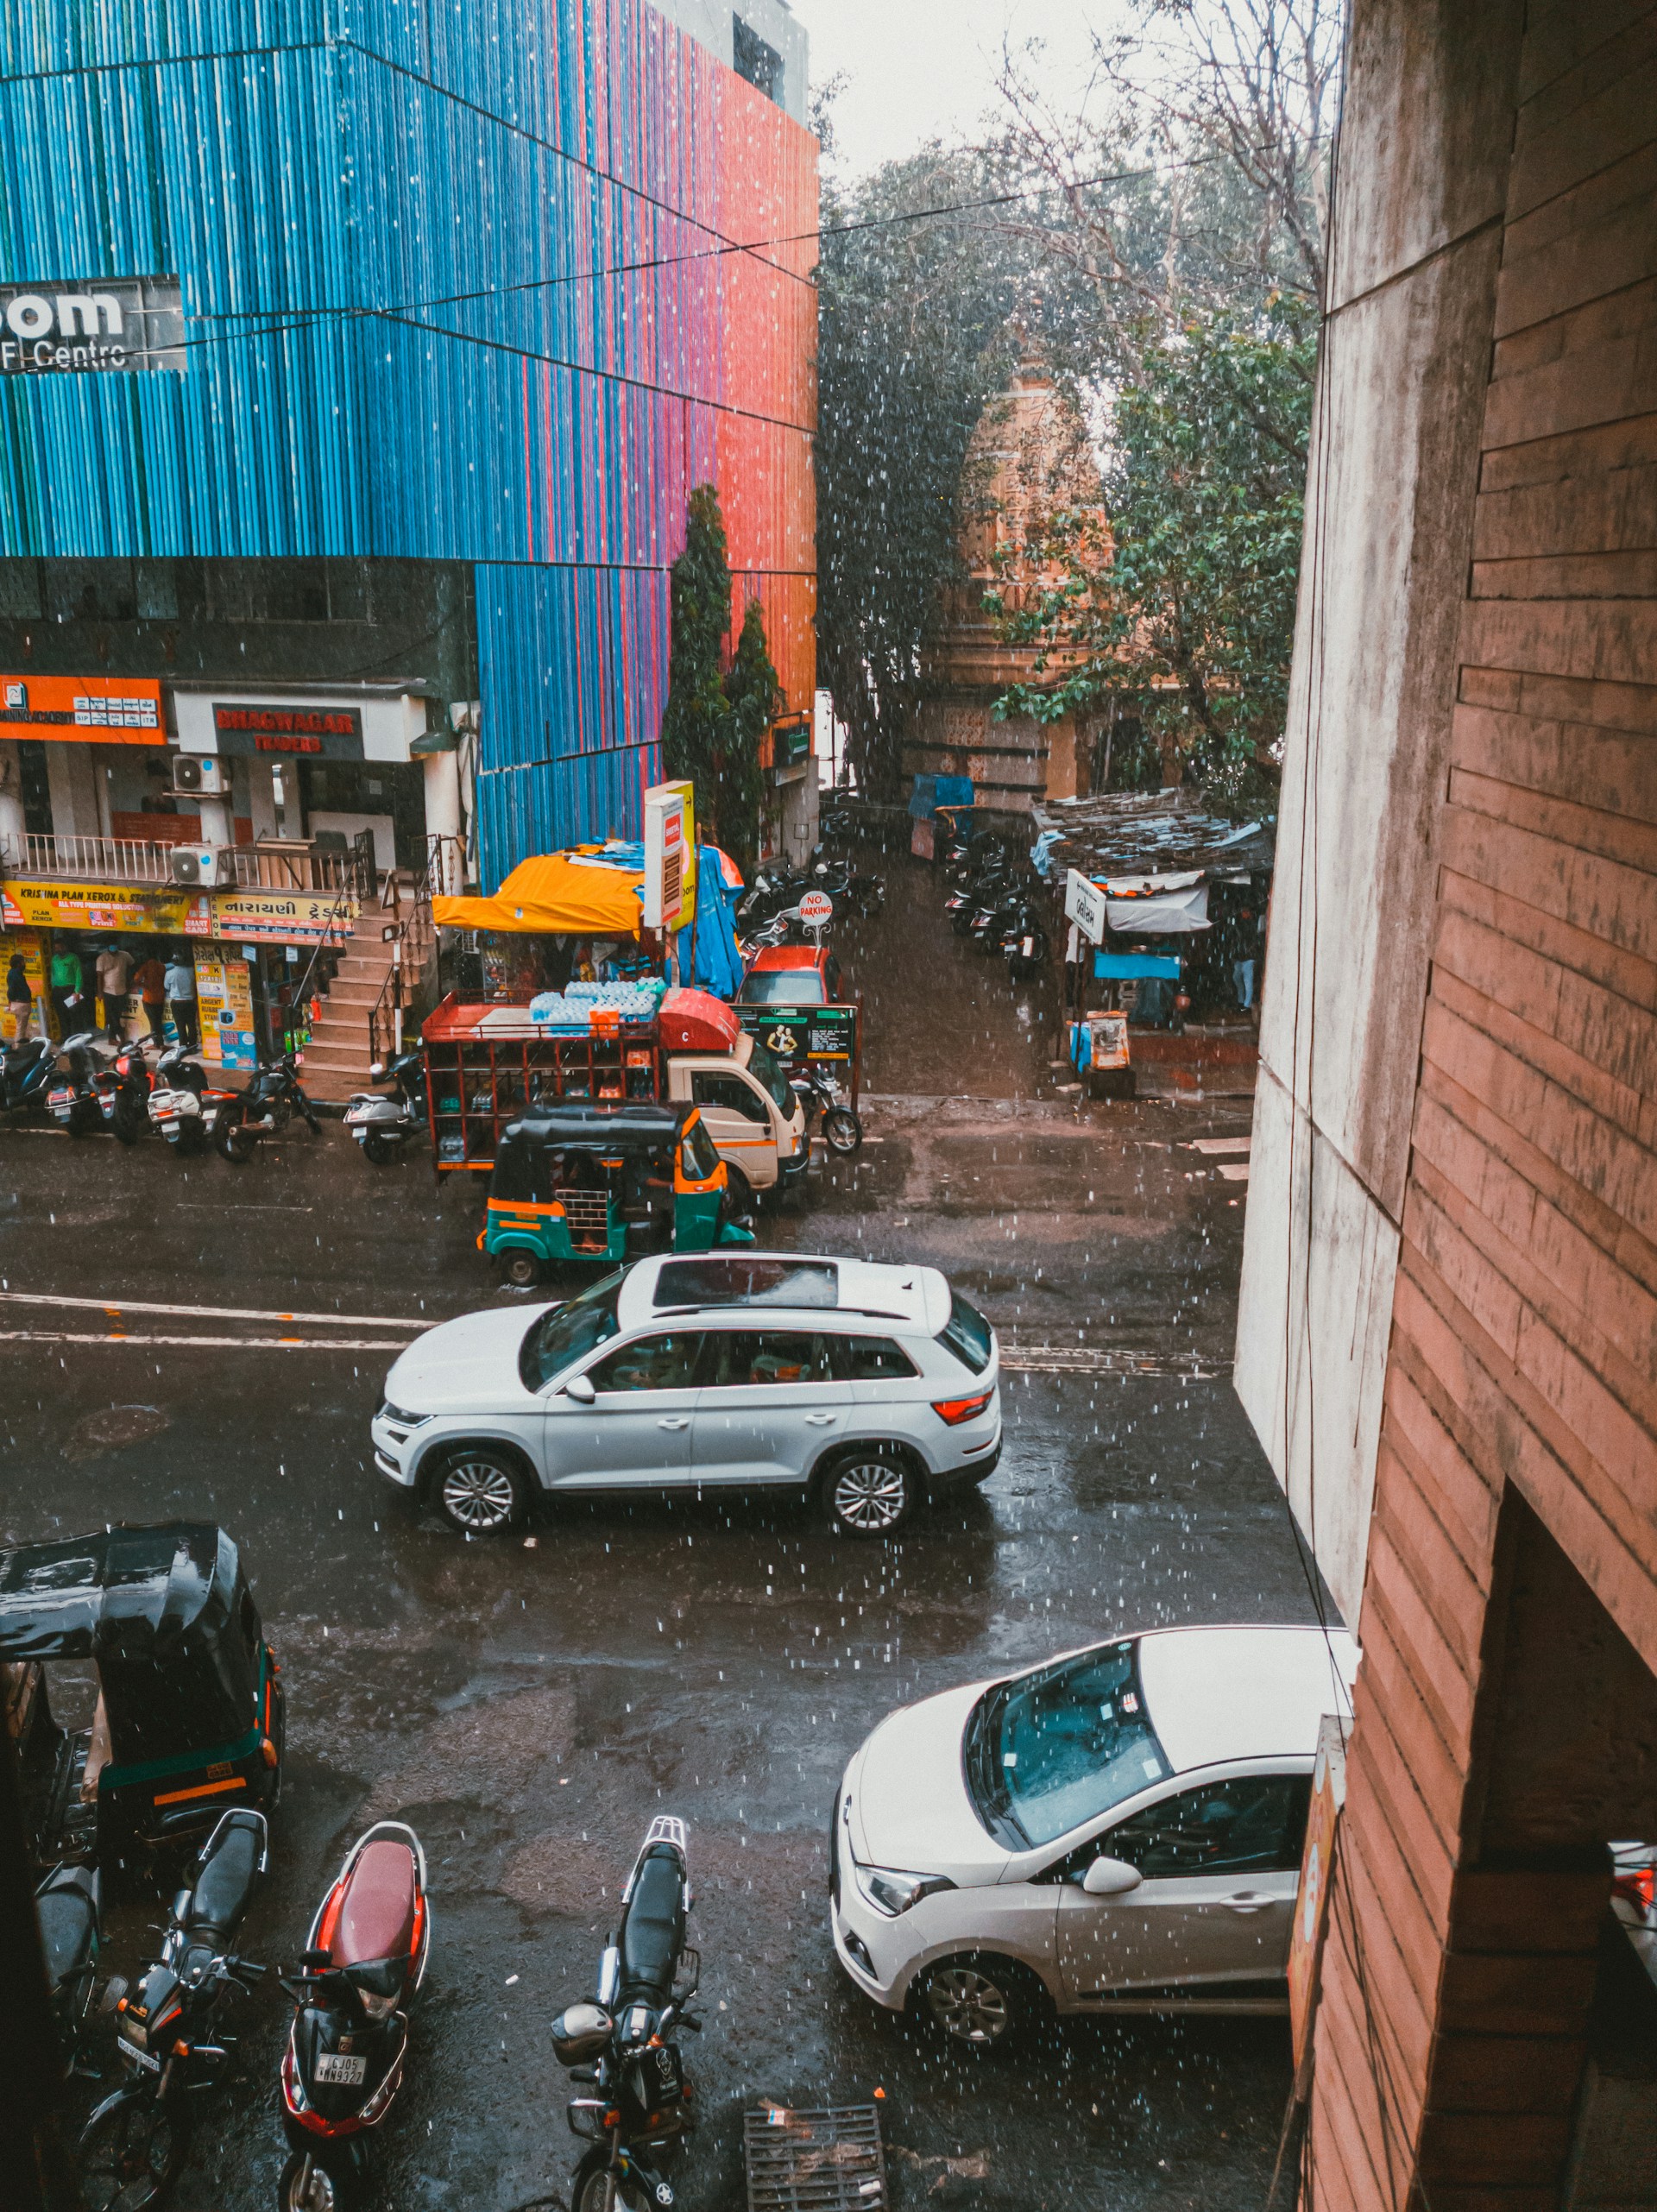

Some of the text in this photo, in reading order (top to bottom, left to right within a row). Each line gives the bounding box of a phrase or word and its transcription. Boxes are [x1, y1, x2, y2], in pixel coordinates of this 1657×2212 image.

[0, 294, 123, 339] om
[61, 891, 84, 900] PLAN
[86, 892, 116, 902] XEROX
[807, 895, 822, 904] NO
[224, 901, 296, 915] નારાયણી
[800, 905, 832, 917] PARKING
[211, 896, 219, 937] XEROX
